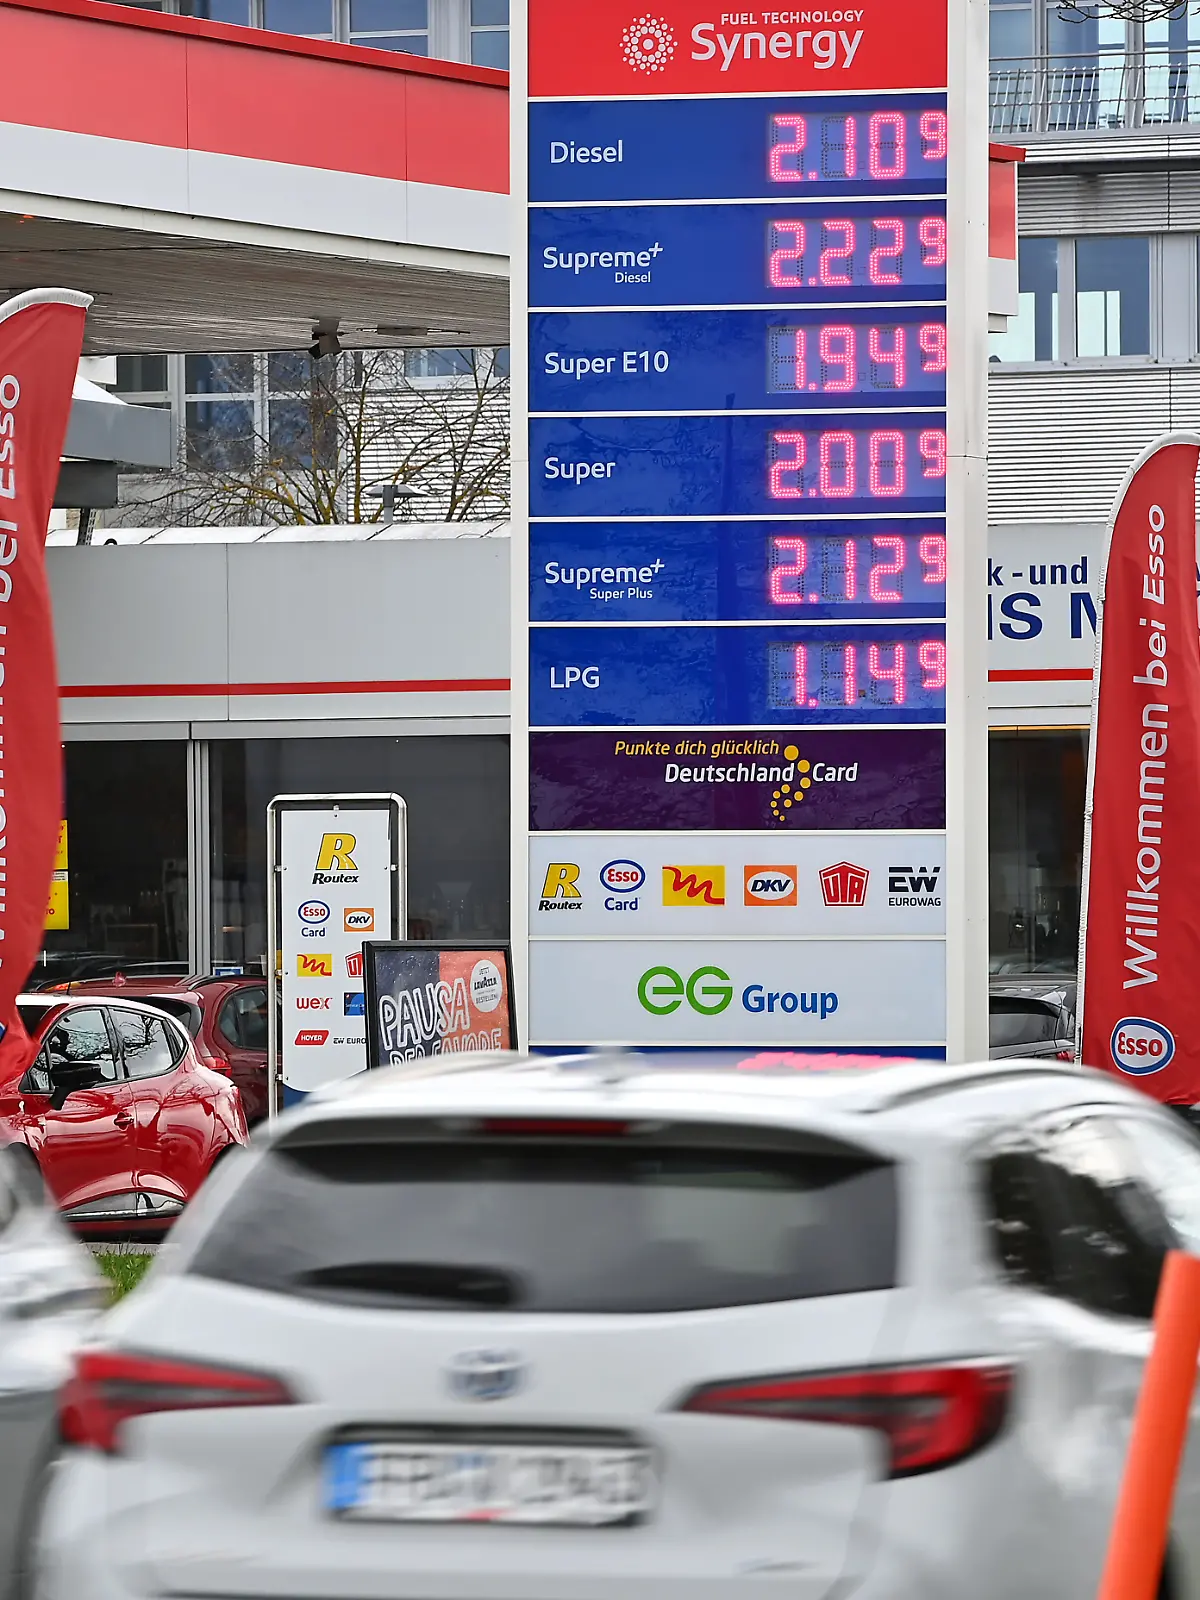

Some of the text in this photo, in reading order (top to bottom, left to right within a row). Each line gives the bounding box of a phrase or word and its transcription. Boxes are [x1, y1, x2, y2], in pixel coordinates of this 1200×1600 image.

[721, 10, 864, 25] FUEL TECHNOLOGY
[691, 23, 864, 71] Synergy
[550, 140, 623, 164] Diesel
[614, 271, 651, 283] Diesel
[544, 350, 669, 380] Super E10
[544, 457, 616, 484] Super
[1143, 504, 1166, 604] Esso
[589, 587, 653, 602] Super Plus
[1133, 618, 1168, 687] bei
[550, 666, 600, 689] LPG
[614, 739, 780, 758] Punkte dich glücklich
[665, 763, 858, 783] Deutschland Card
[1123, 703, 1168, 990] Willkommen
[311, 873, 359, 885] Routex
[607, 868, 639, 883] Esso
[820, 863, 868, 904] UTA
[751, 879, 792, 893] DKV
[303, 906, 326, 917] Esso
[538, 899, 583, 911] Routex
[604, 897, 638, 911] Card
[888, 897, 942, 907] EUROWAG
[347, 915, 371, 924] DKV
[301, 927, 326, 937] Card
[741, 984, 839, 1020] Group
[379, 977, 471, 1051] PAUSA
[1117, 1031, 1163, 1057] Esso
